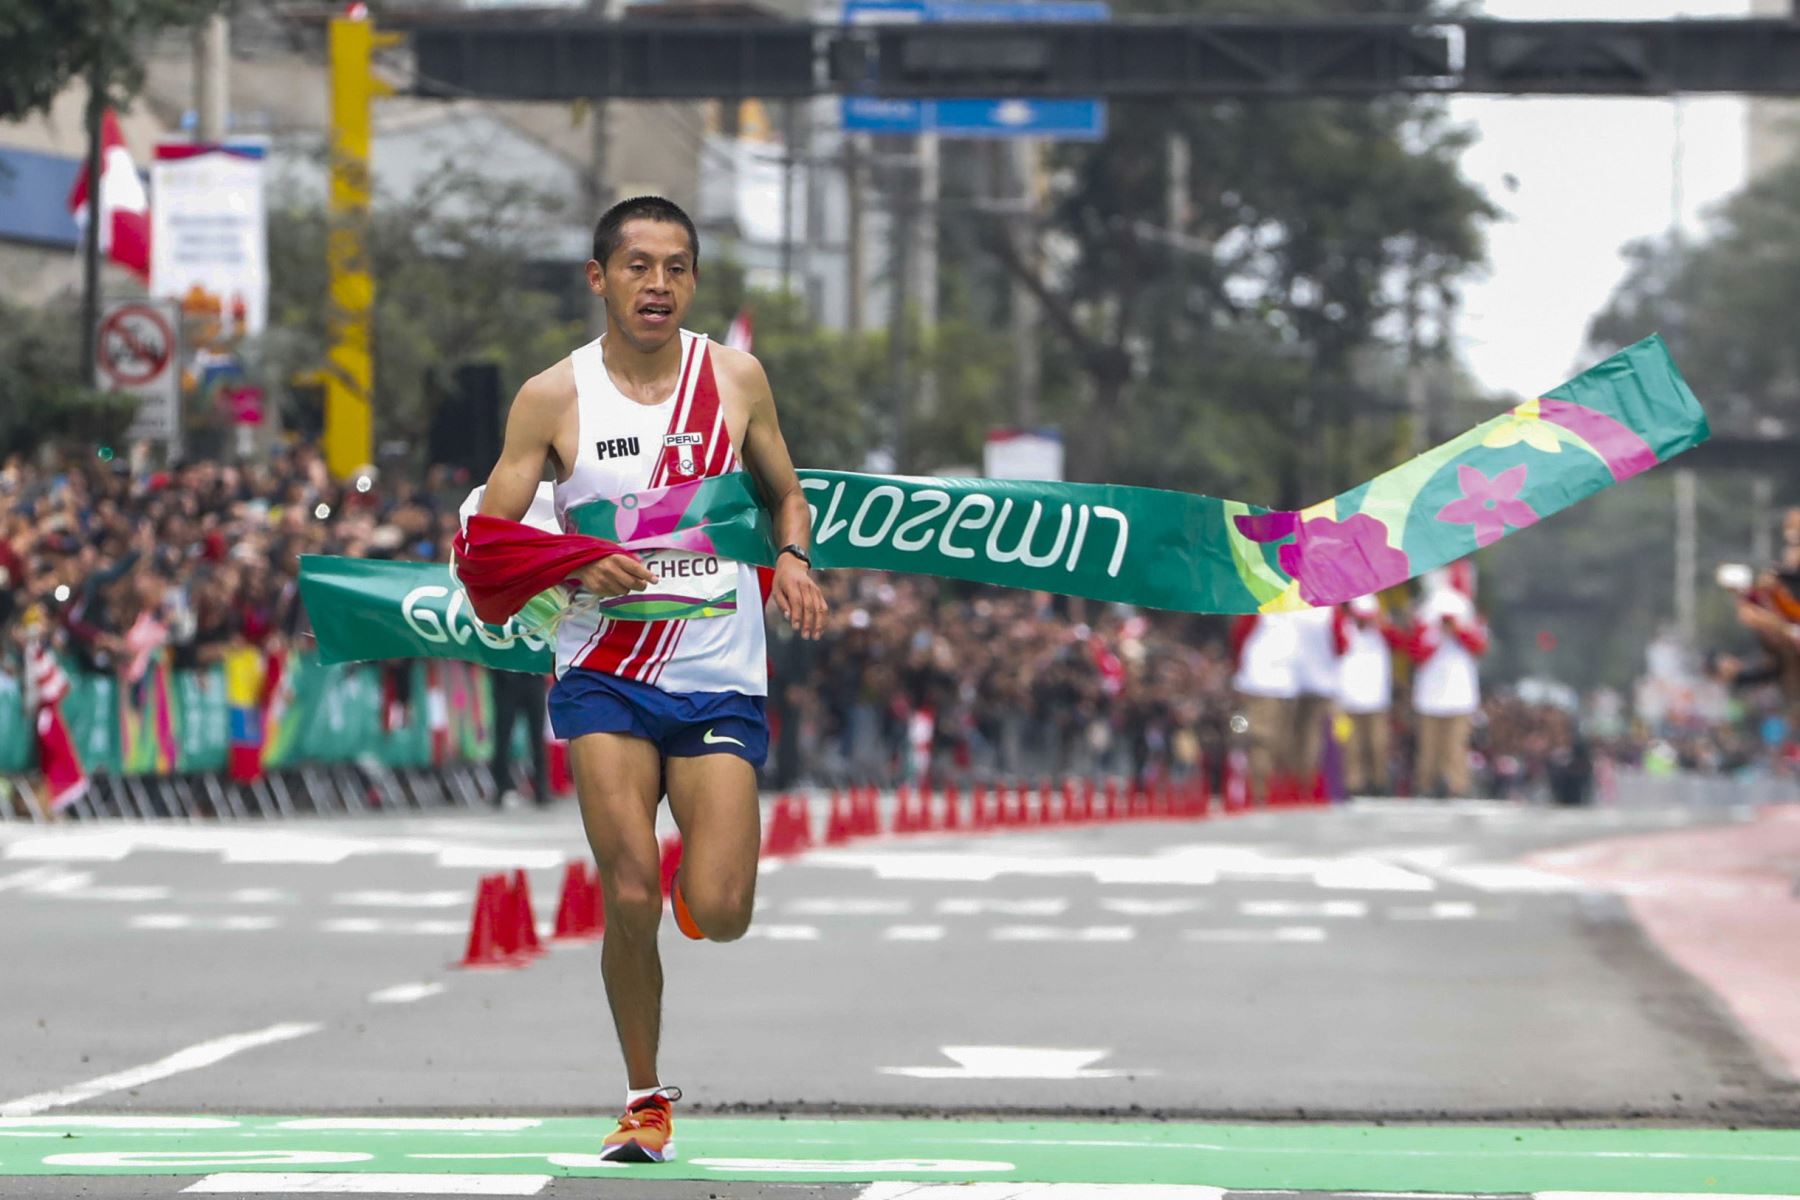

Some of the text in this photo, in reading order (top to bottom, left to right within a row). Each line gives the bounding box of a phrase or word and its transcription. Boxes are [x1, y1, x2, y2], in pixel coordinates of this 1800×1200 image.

[596, 436, 640, 461] PERU
[667, 434, 700, 445] PERU
[646, 556, 719, 578] CHECO
